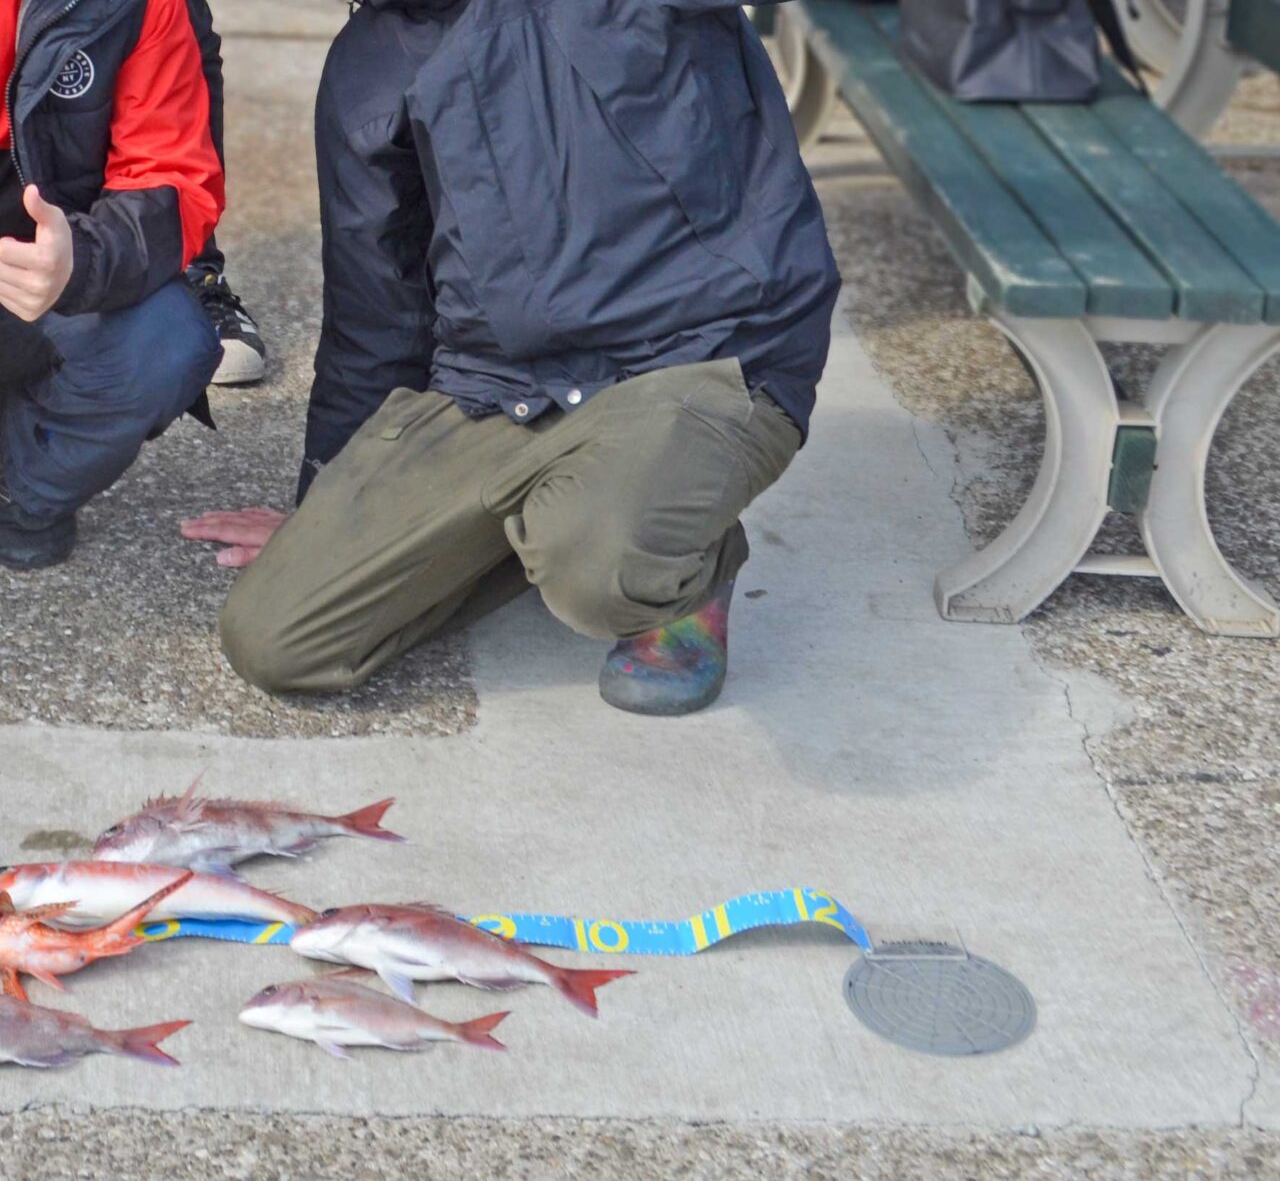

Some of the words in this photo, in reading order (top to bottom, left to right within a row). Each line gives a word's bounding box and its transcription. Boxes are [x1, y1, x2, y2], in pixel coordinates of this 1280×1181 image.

[690, 903, 733, 950] 11
[794, 887, 846, 931] 12
[574, 919, 629, 952] 10
